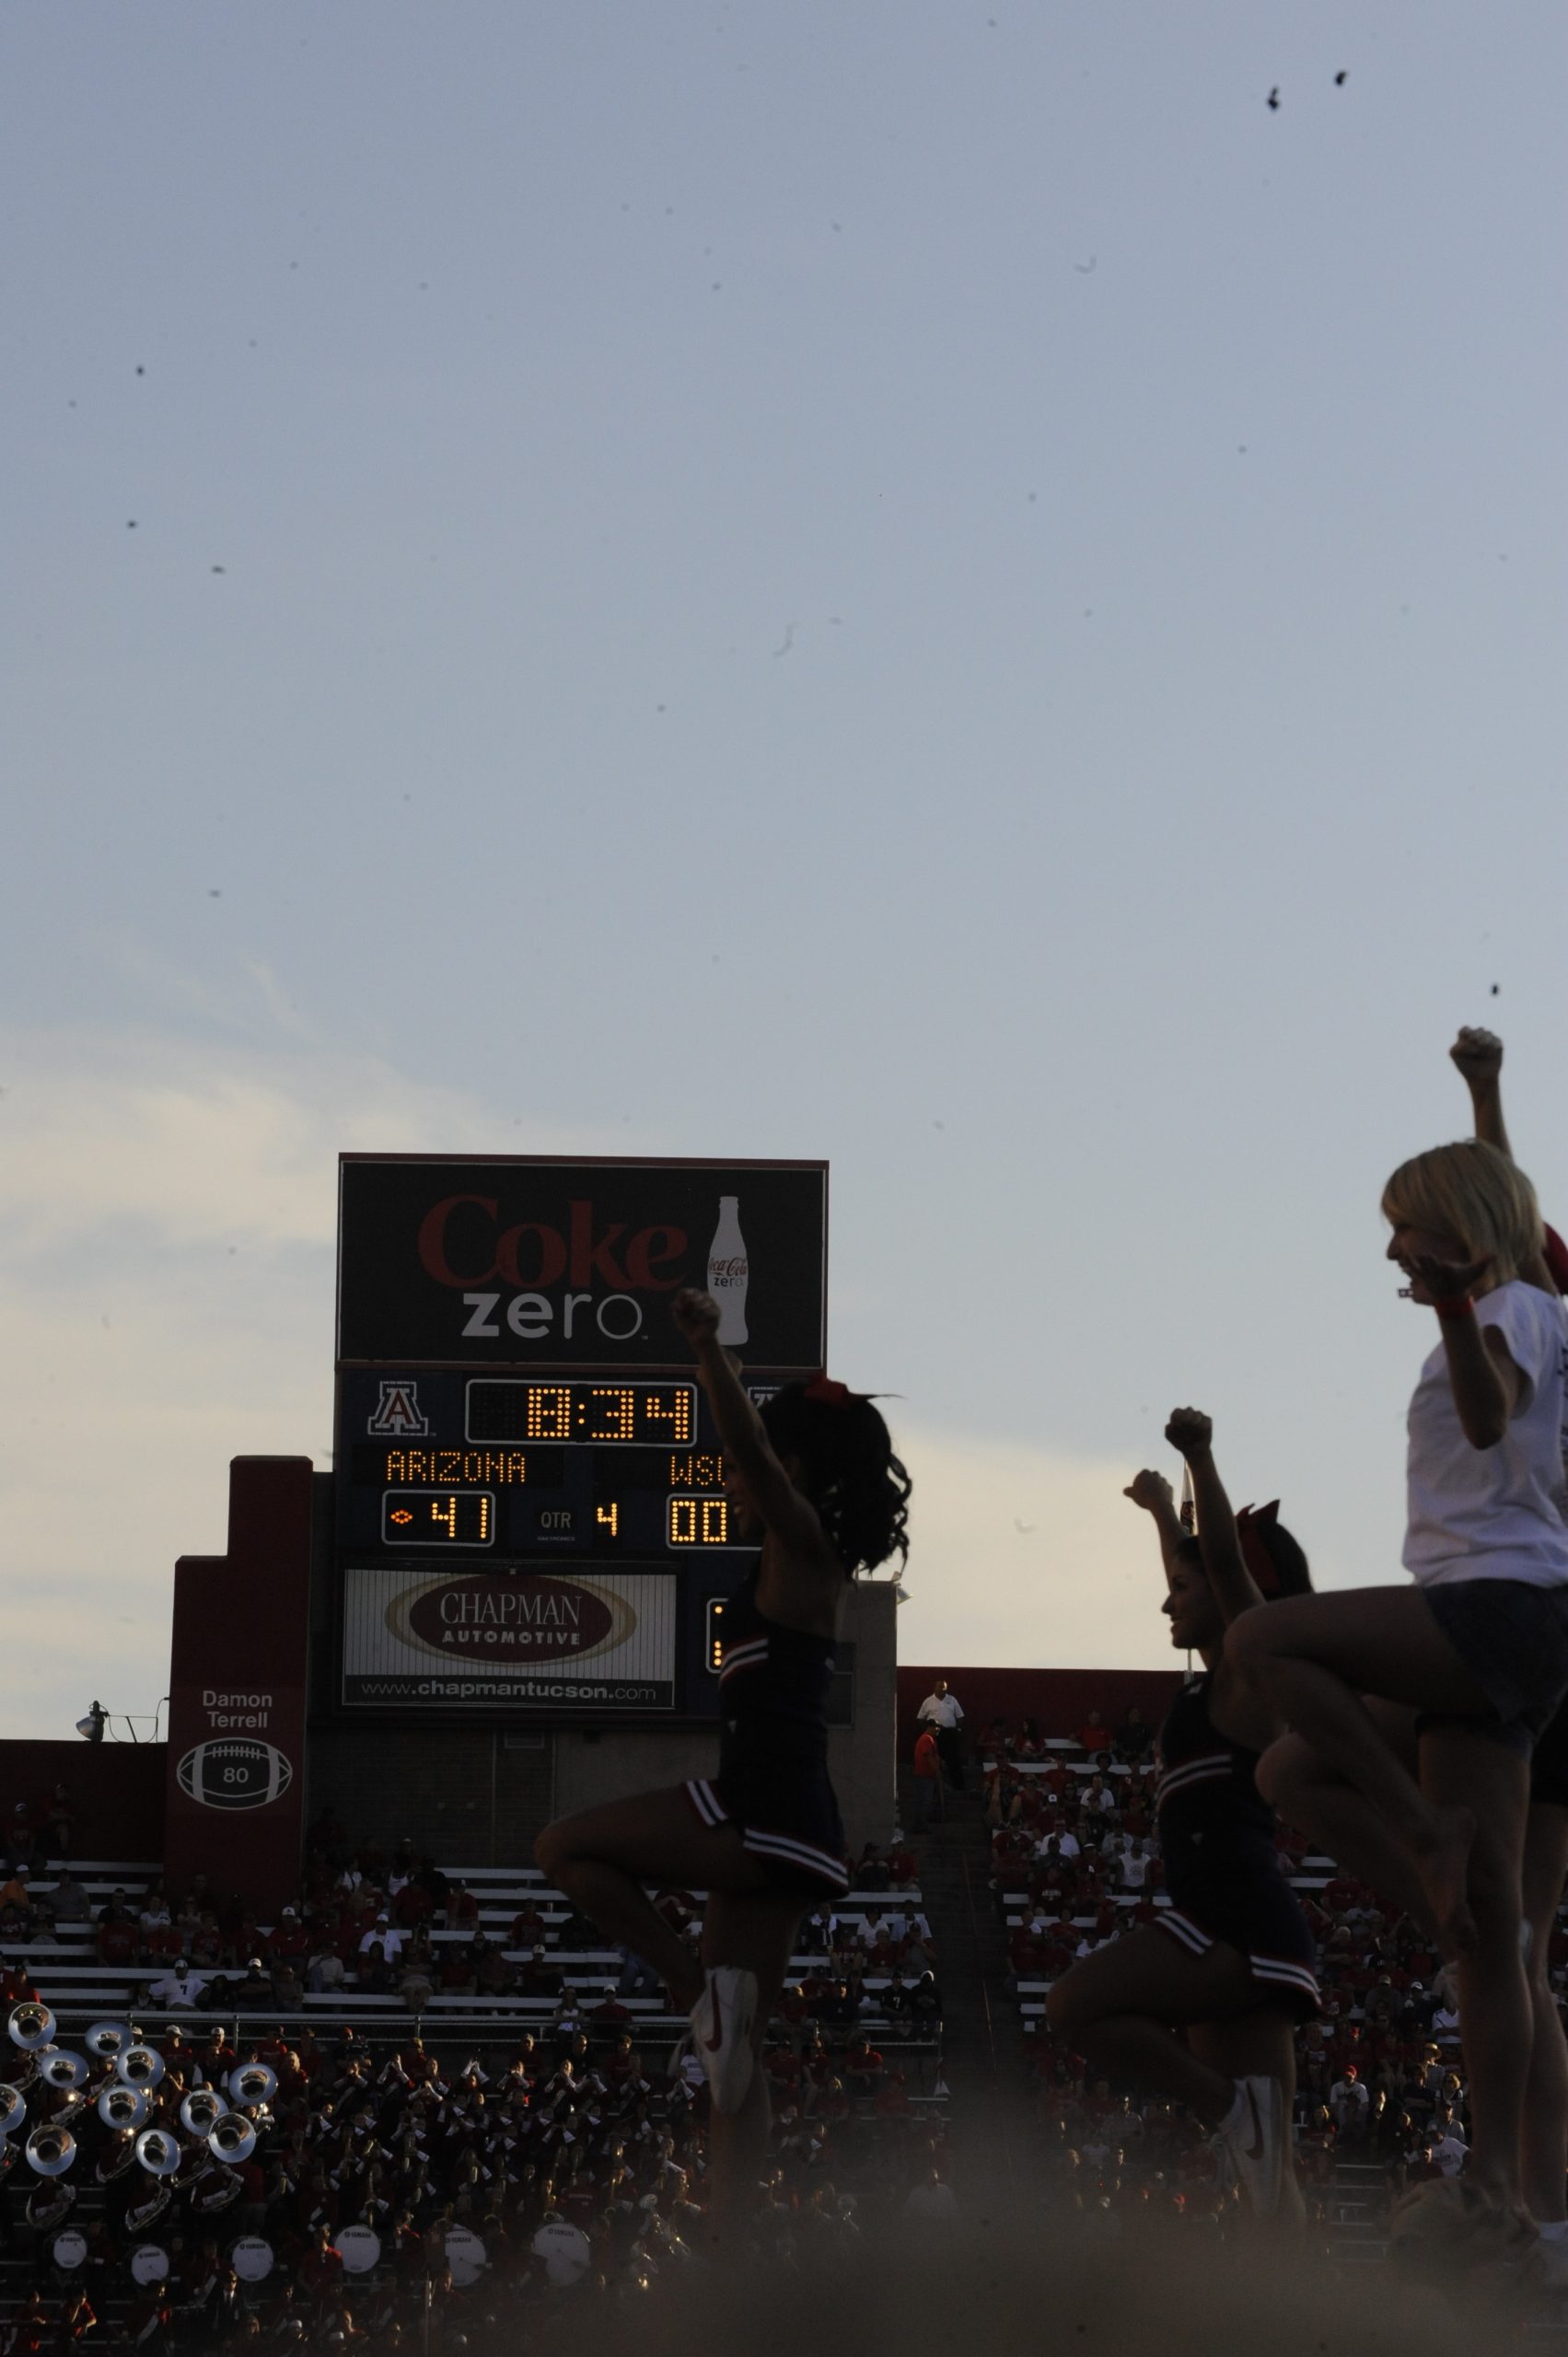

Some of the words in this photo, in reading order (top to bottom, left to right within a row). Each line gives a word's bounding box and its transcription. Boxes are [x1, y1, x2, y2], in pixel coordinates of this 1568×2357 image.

[417, 1194, 688, 1291] Coke
[714, 1277, 745, 1287] zero
[461, 1293, 643, 1340] zero
[367, 1380, 429, 1436] A
[528, 1387, 690, 1441] 8:34
[386, 1449, 527, 1483] ARIZONA
[431, 1496, 488, 1539] 41
[540, 1511, 571, 1529] QTR
[596, 1503, 618, 1537] 4
[671, 1500, 727, 1543] 00
[439, 1592, 583, 1627] CHAPMAN
[442, 1630, 581, 1646] AUTOMOTIVE
[202, 1689, 273, 1707] Damon
[361, 1679, 656, 1701] www.chapmantucson.com
[207, 1711, 268, 1728] Terrell
[223, 1767, 249, 1783] 80
[180, 1984, 188, 1996] 7
[892, 1996, 901, 2009] 7
